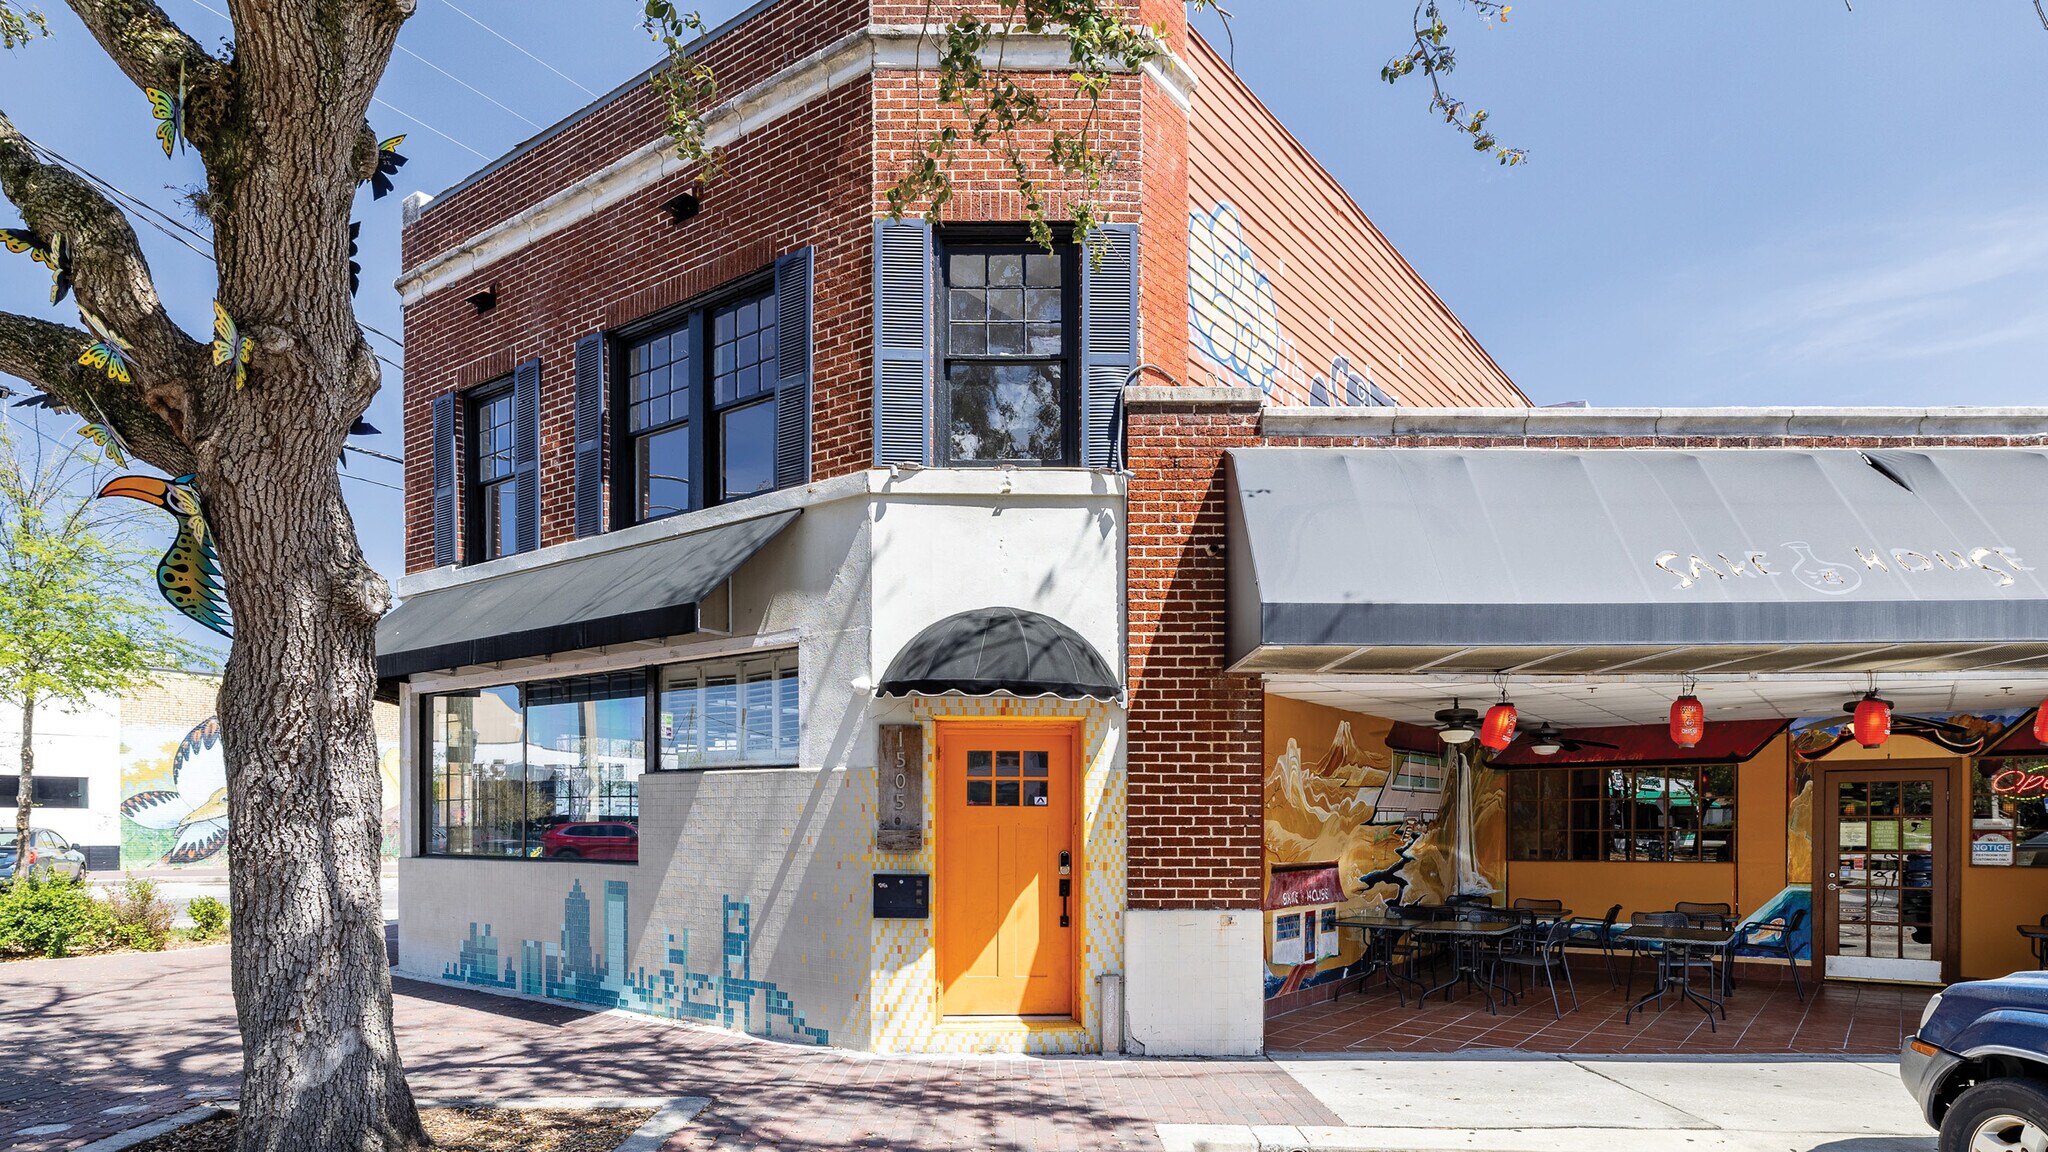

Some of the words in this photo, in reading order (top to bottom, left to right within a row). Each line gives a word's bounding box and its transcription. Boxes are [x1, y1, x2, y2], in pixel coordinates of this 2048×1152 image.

[1655, 550, 1784, 590] SAKE
[1851, 545, 2037, 588] HOUSE
[895, 731, 906, 810] 1505
